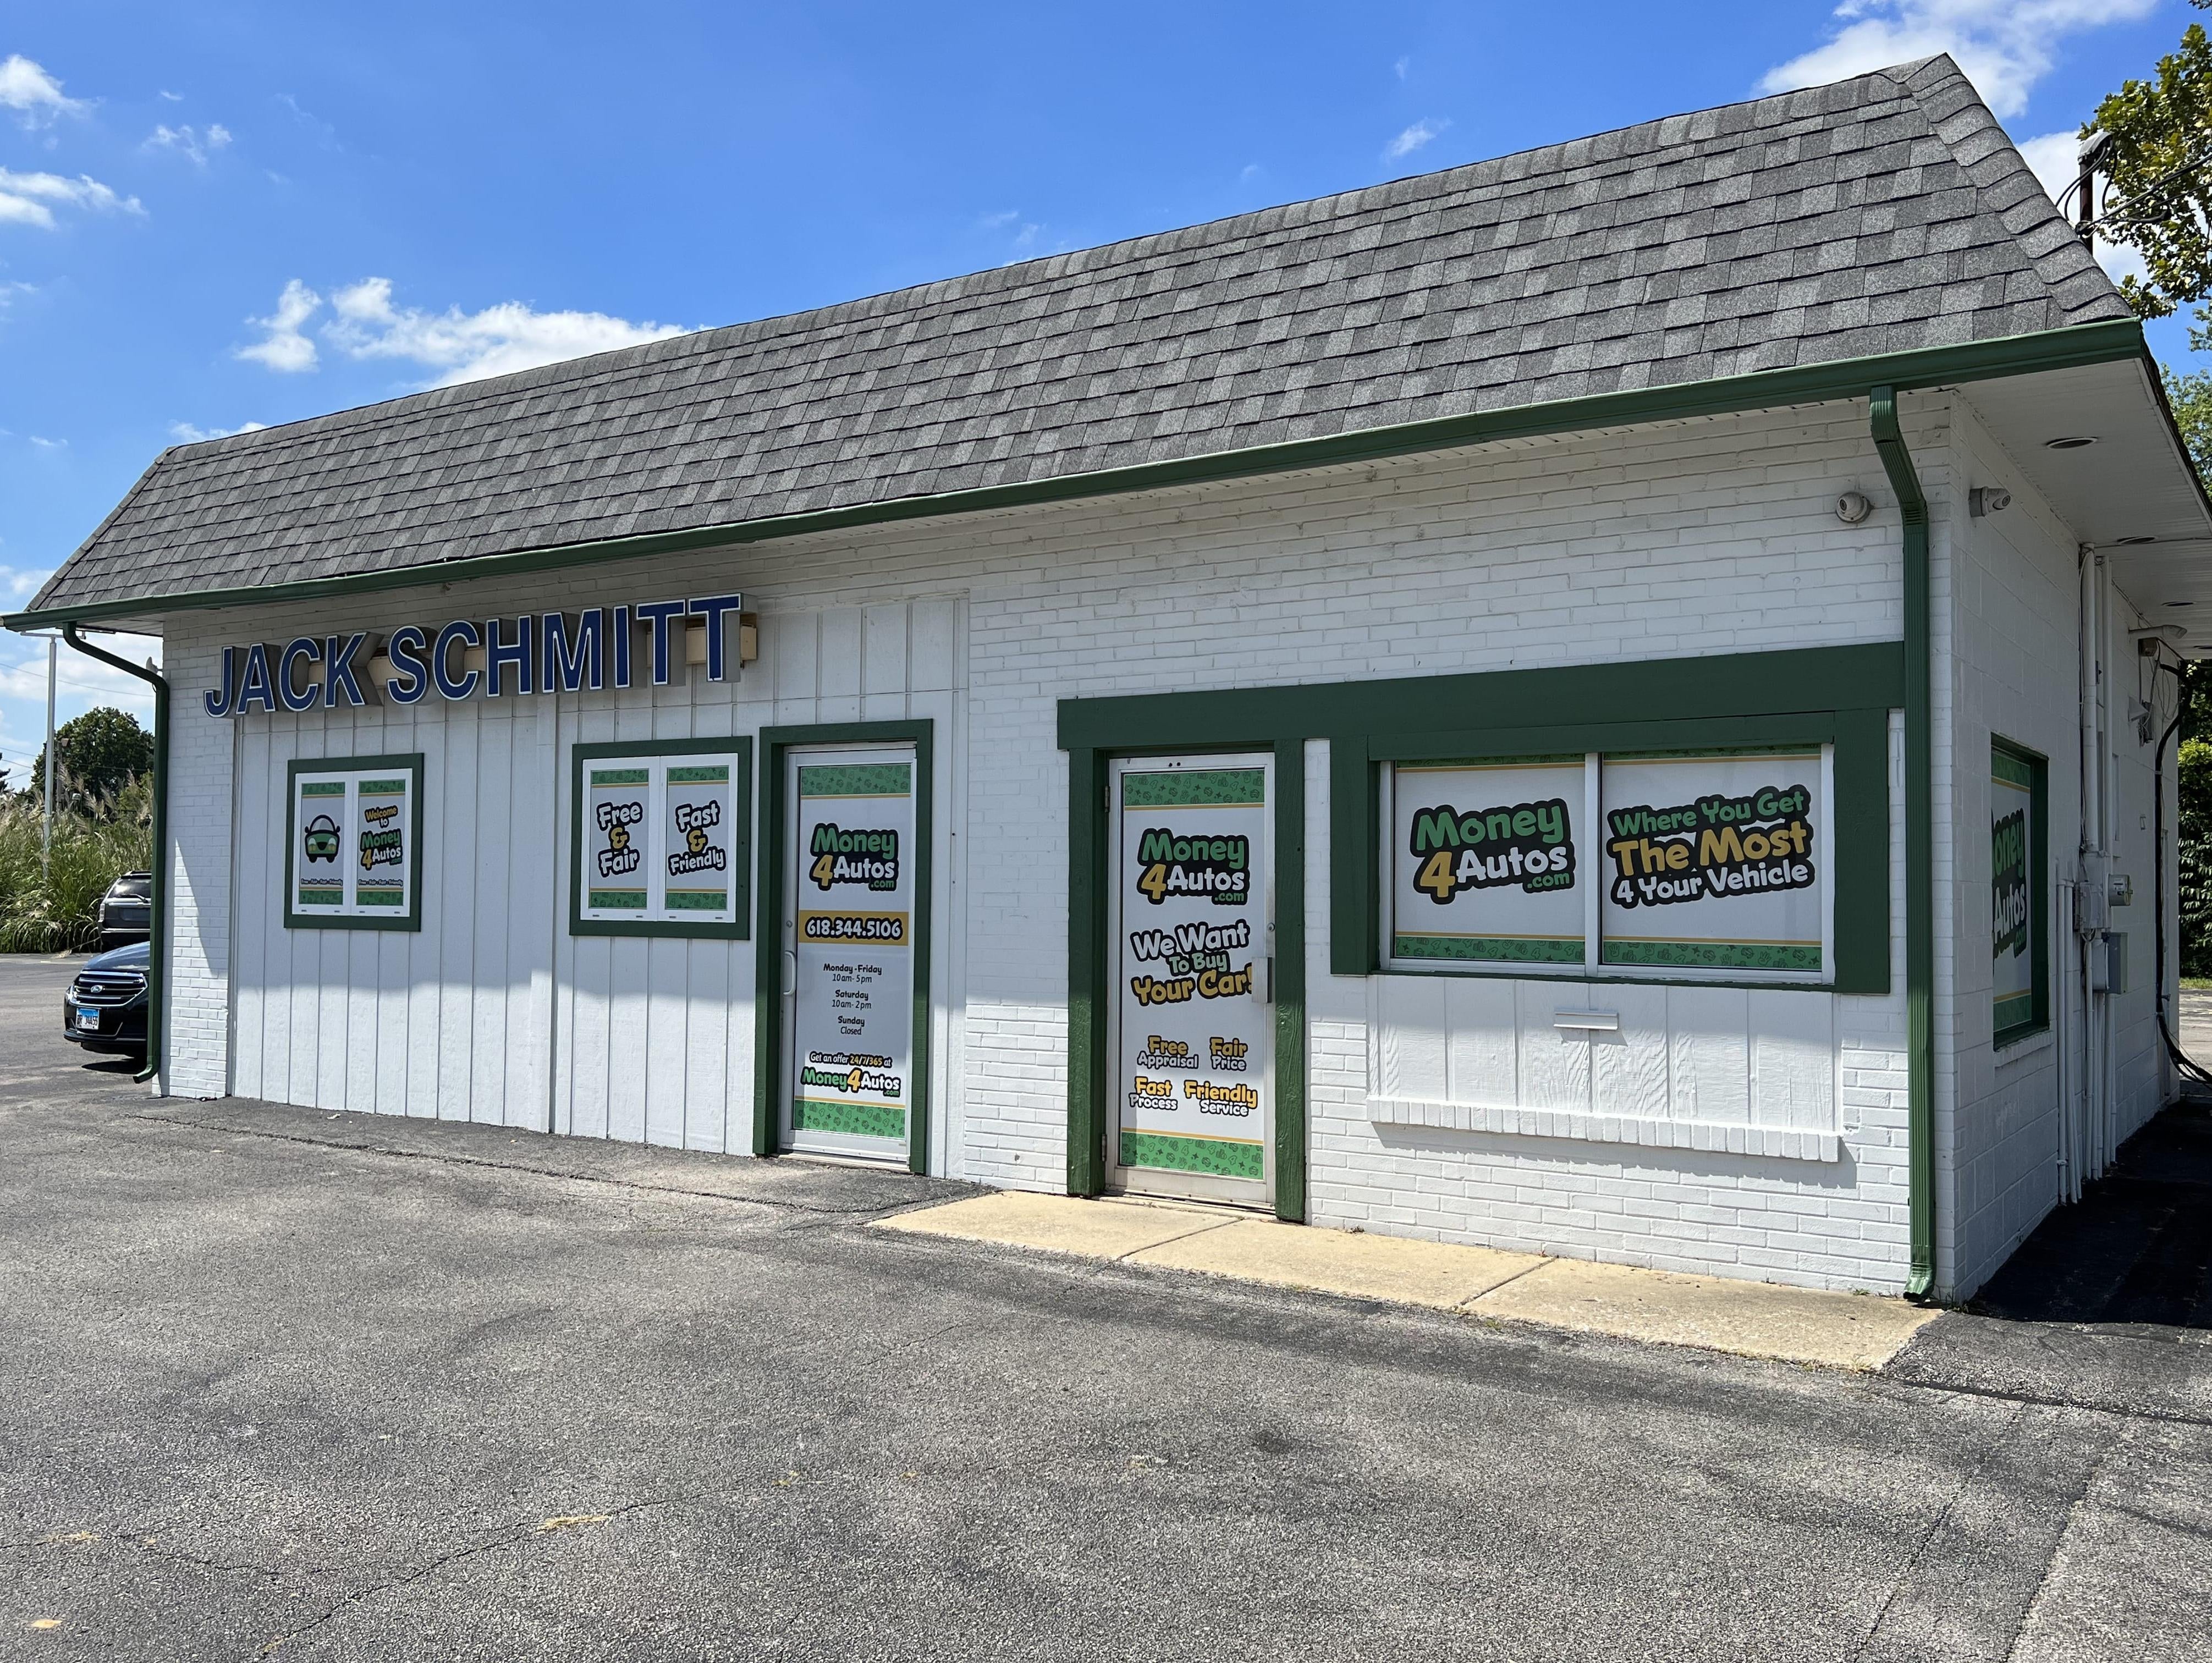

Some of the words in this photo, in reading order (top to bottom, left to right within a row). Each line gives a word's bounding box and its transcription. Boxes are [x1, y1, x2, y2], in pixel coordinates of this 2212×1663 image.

[203, 632, 366, 719] JACK
[387, 592, 741, 706] SCHMITT
[365, 807, 398, 821] Welcome
[380, 818, 388, 826] to
[598, 805, 641, 828] Free
[677, 803, 718, 830] Fast
[1614, 810, 1697, 836] Where
[1701, 801, 1751, 824] You
[1757, 791, 1804, 816] Get
[610, 827, 628, 849] &
[1416, 805, 1565, 851] Money
[361, 831, 401, 850] Money
[689, 829, 706, 852] &
[813, 828, 895, 860] Money
[1142, 833, 1245, 869] Money
[1613, 838, 1690, 877] The
[1699, 821, 1807, 867] Most
[1992, 821, 2024, 880] oney
[362, 847, 401, 868] 4Autos
[600, 849, 639, 875] Fair
[670, 849, 724, 873] Friendly
[812, 854, 895, 886] 4Autos
[1419, 846, 1569, 898] 4Autos
[1527, 872, 1570, 889] .com
[1616, 879, 1635, 902] 4
[1638, 875, 1703, 901] Your
[1706, 859, 1808, 892] Vehicle
[870, 880, 894, 888] .com
[1141, 863, 1245, 900] 4Autos
[1214, 893, 1245, 902] .com
[1993, 883, 2026, 944] Autos
[806, 919, 901, 937] 618.344.5106
[1133, 932, 1175, 959] We
[1177, 922, 1247, 952] Want
[823, 963, 853, 974] Monday
[1169, 956, 1190, 973] To
[1191, 952, 1227, 972] Buy
[835, 990, 868, 1001] Saturday
[1133, 978, 1193, 1004] Your
[838, 1016, 865, 1027] Sunday
[840, 1026, 862, 1035] Closed
[1148, 1037, 1188, 1055] Free
[1210, 1038, 1247, 1057] Fair
[810, 1053, 822, 1061] Get
[833, 1055, 849, 1064] offer
[850, 1055, 883, 1066] 24/7/365
[1137, 1051, 1199, 1069] Appraisal
[1212, 1056, 1247, 1071] Price
[802, 1069, 900, 1092] Money4Autos
[1135, 1077, 1172, 1096] Fast
[1129, 1094, 1177, 1110] Process
[1185, 1081, 1258, 1109] Friendly
[1200, 1100, 1249, 1116] Service
